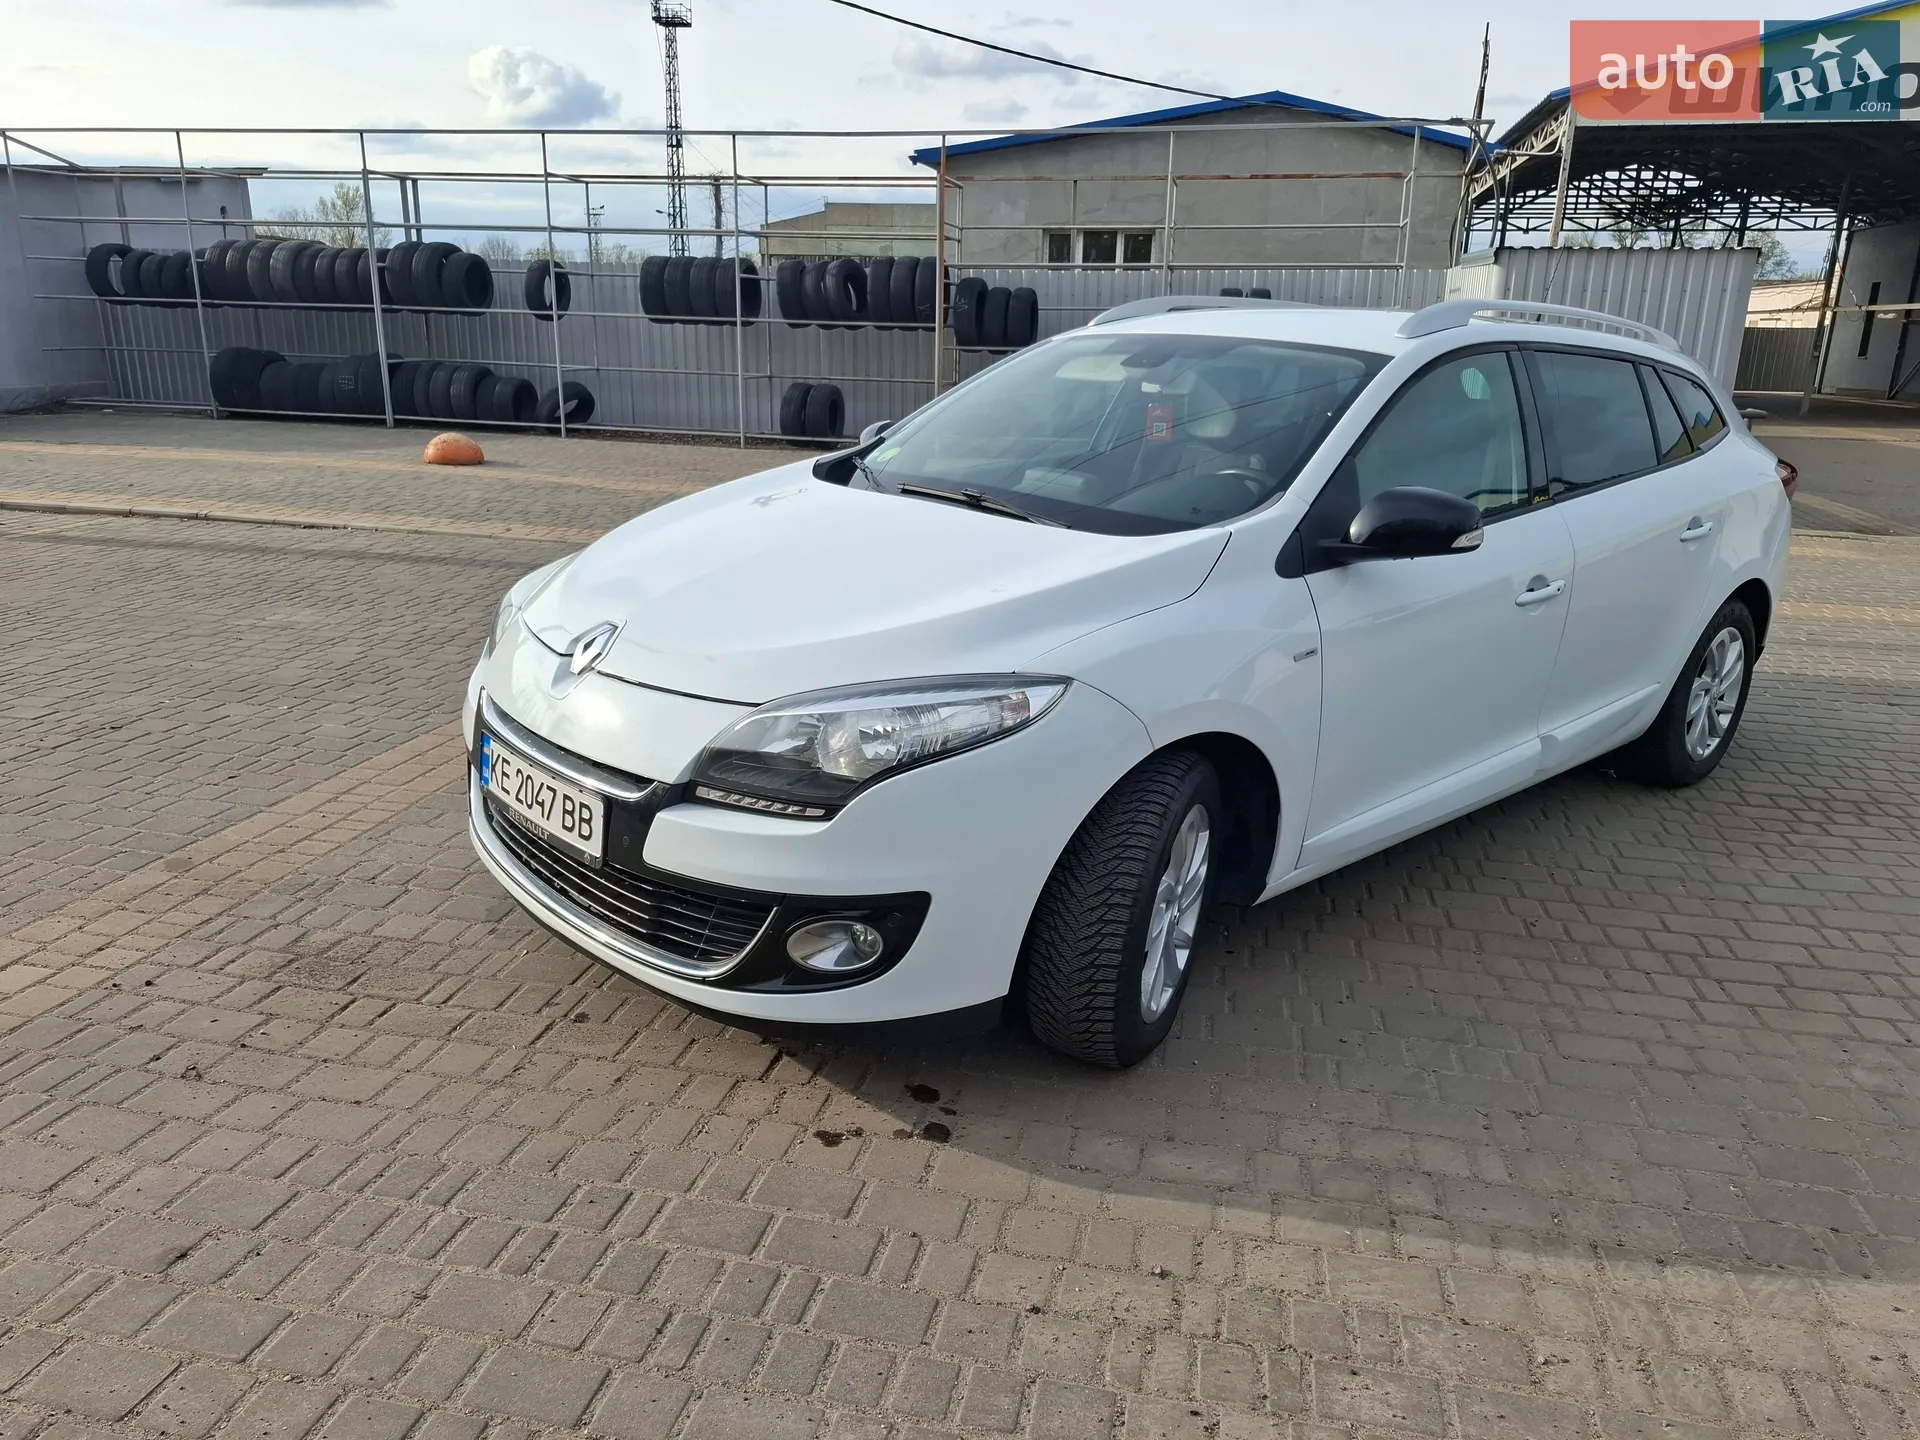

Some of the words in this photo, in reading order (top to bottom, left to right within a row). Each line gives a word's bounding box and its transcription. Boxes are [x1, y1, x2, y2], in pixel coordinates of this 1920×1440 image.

[490, 748, 512, 797] KE
[515, 767, 557, 822] 2047
[561, 793, 594, 841] BB
[508, 807, 550, 840] RENAULT
